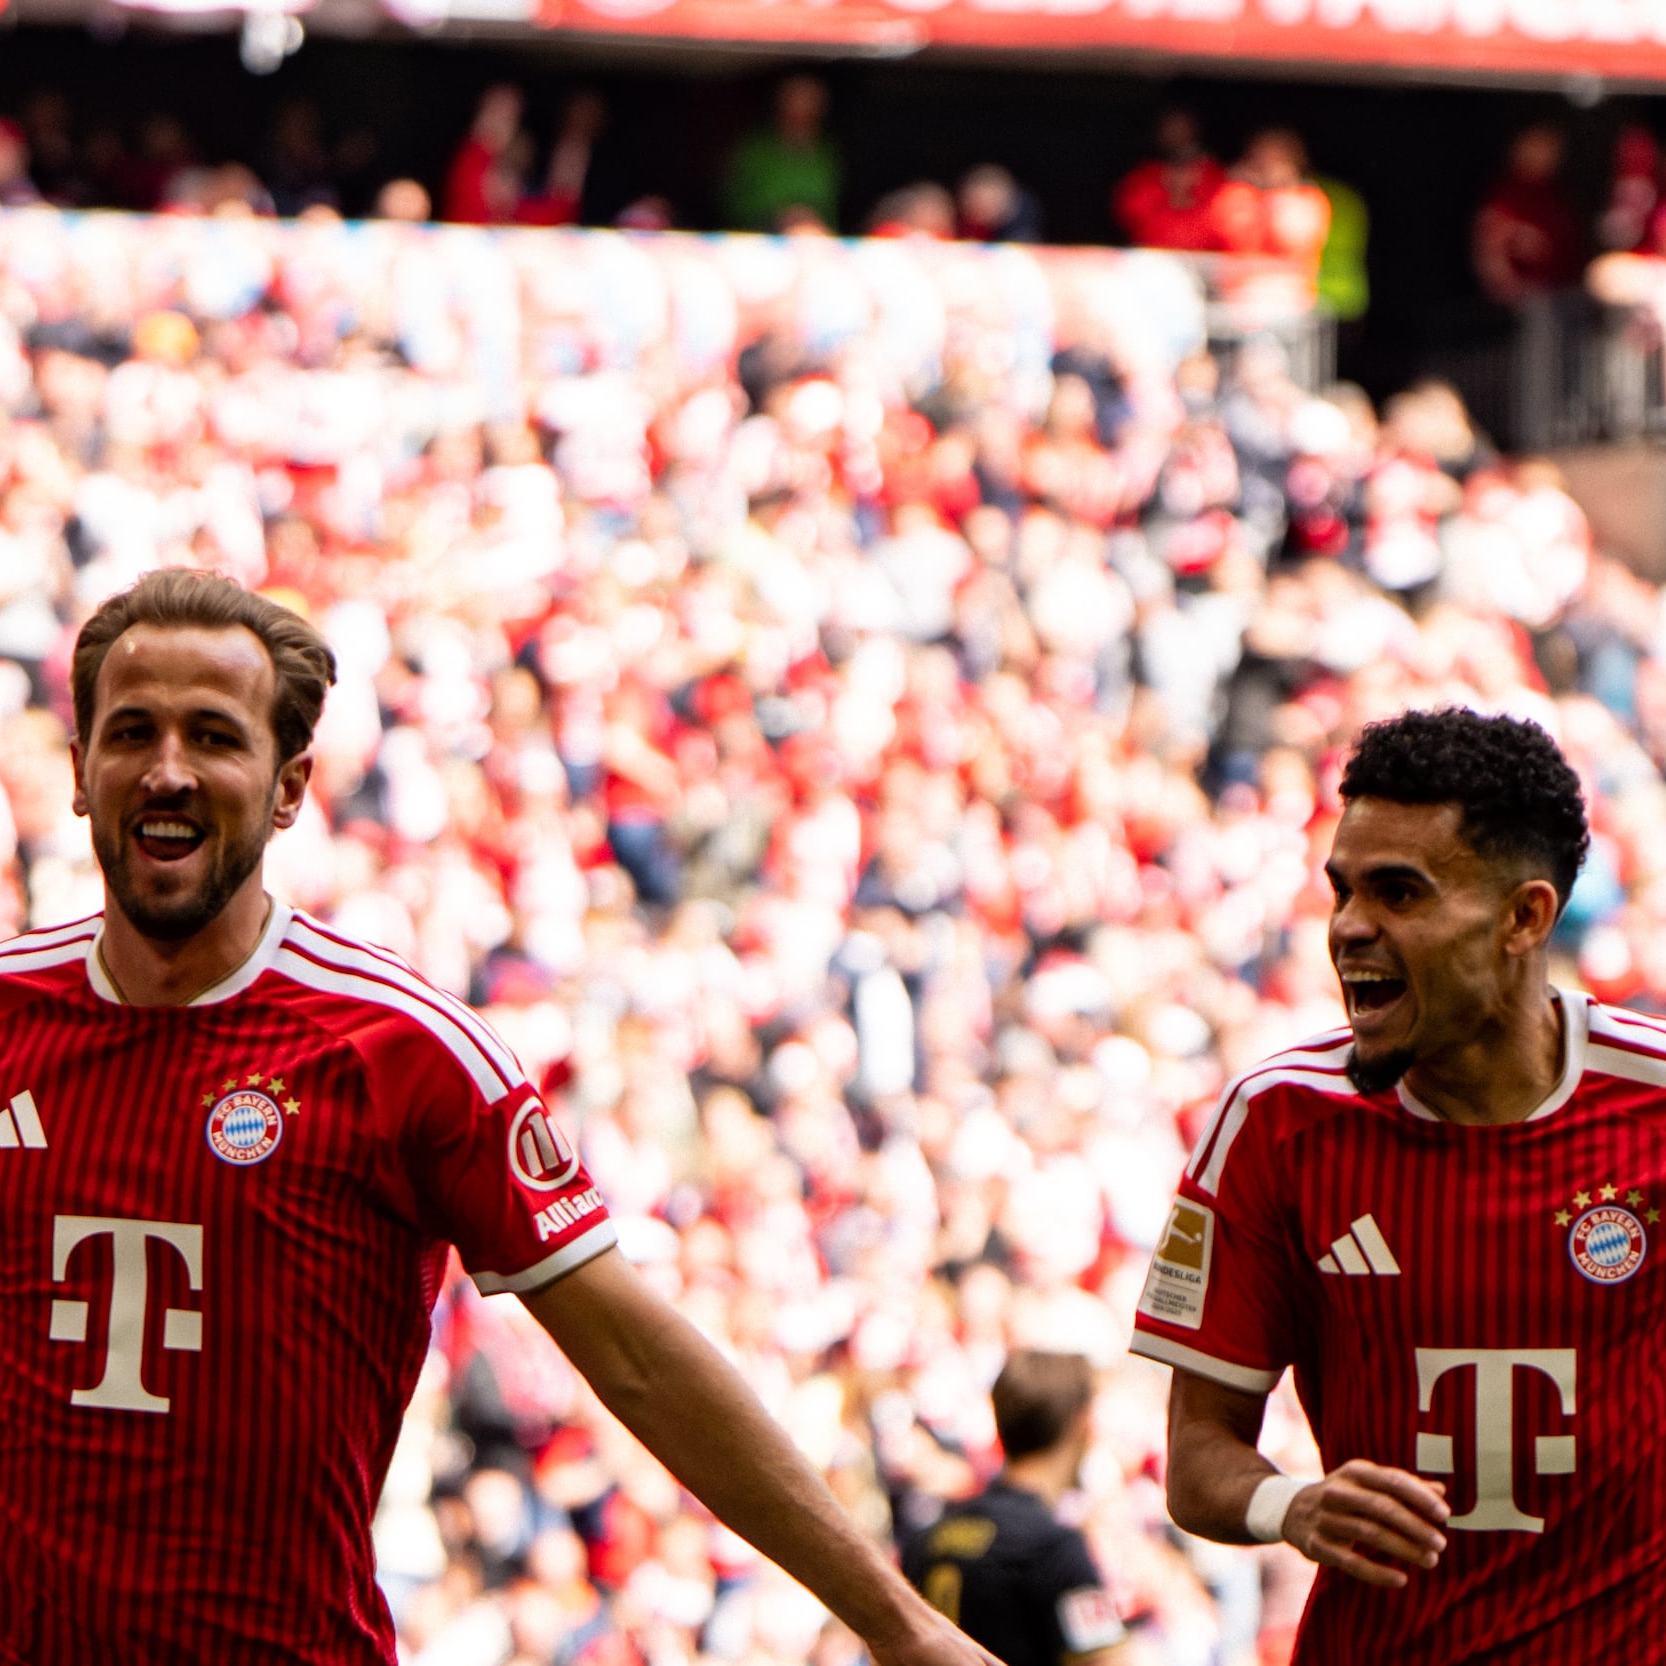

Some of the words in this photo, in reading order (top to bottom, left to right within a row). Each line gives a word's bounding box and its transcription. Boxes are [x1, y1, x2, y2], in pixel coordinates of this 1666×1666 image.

[233, 1095, 278, 1126] BAYERN
[533, 1186, 604, 1242] Allian
[1590, 1211, 1641, 1238] BAYERN
